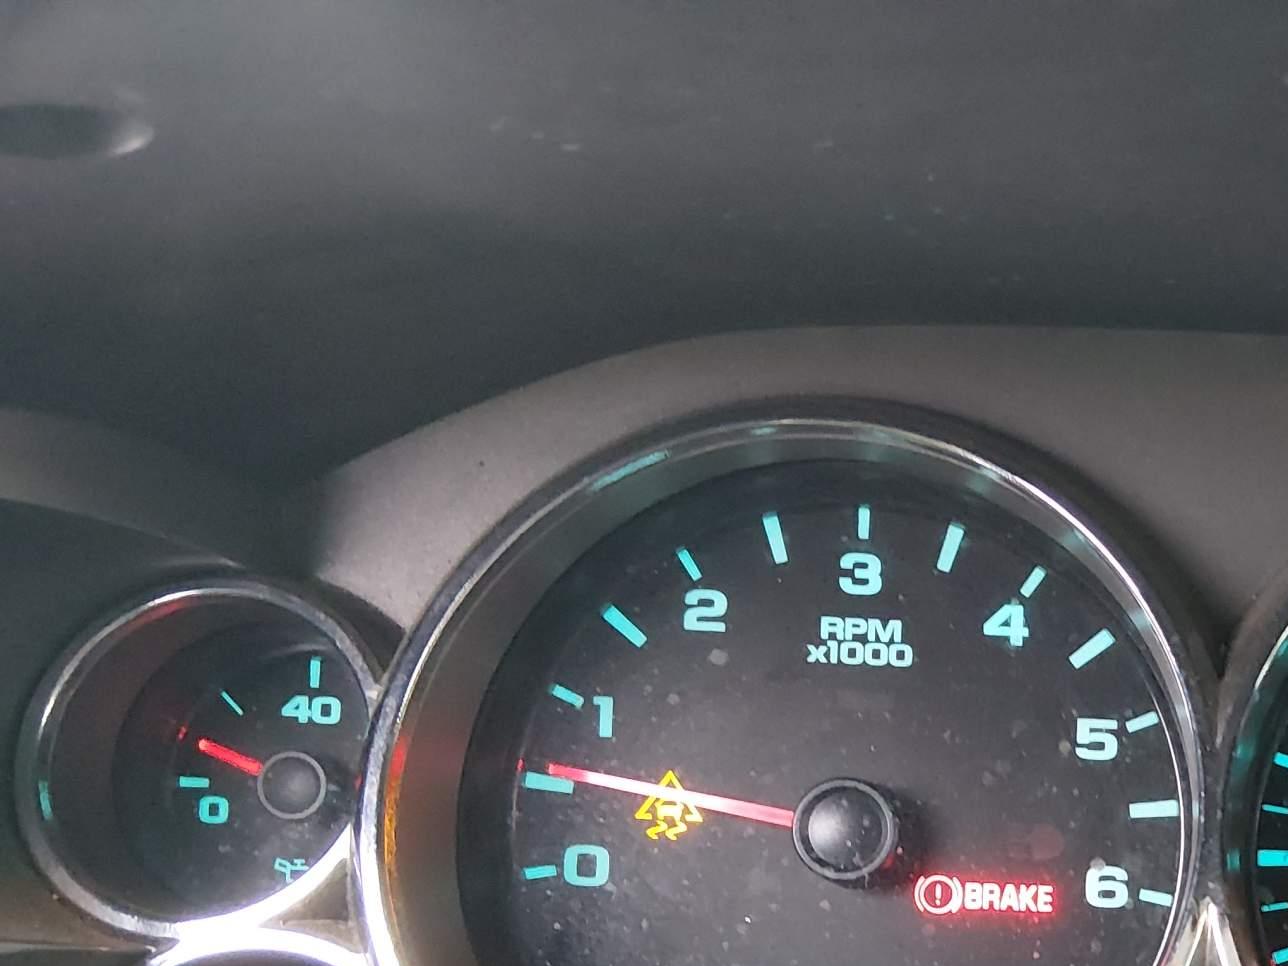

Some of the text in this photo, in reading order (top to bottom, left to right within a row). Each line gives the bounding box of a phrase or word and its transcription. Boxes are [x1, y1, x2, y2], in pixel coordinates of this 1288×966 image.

[838, 552, 883, 596] 3
[683, 588, 728, 633] 2
[819, 616, 903, 642] RPM
[982, 601, 1029, 647] 4
[806, 642, 914, 668] x1000
[281, 695, 342, 725] 40
[593, 695, 614, 738] 1
[1074, 717, 1119, 762] 5
[198, 795, 229, 825] 0
[562, 844, 610, 887] 0
[1084, 865, 1129, 909] 6
[963, 881, 1055, 913] BRAKE
